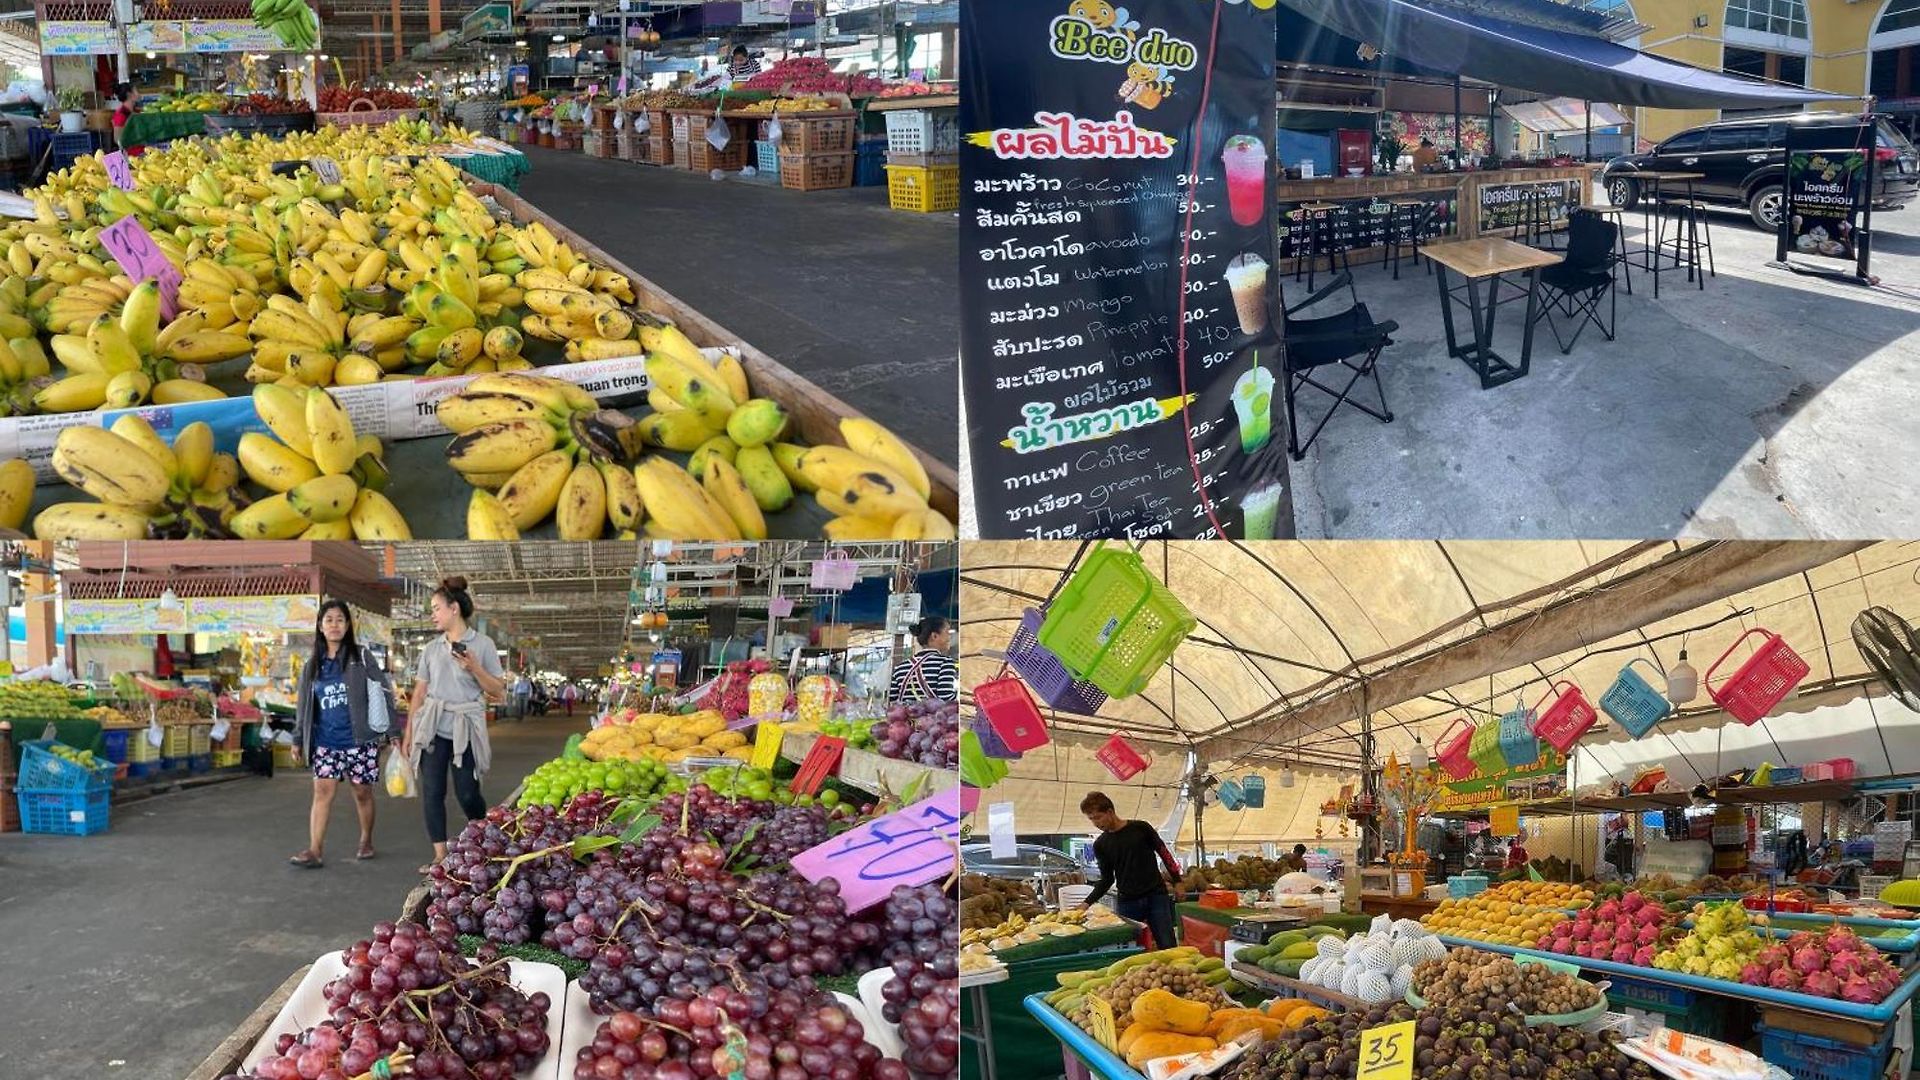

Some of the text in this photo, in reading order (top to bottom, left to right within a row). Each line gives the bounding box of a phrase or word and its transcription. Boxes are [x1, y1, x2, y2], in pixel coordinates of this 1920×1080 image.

[1055, 18, 1195, 68] Bee duo
[995, 112, 1170, 156] ผลไม้ปั่น
[973, 172, 1062, 193] มะพร้าว
[976, 200, 1082, 228] ส้มคั้นสด
[979, 234, 1085, 262] อาโวคาโด
[987, 264, 1060, 291] แตงโม
[990, 303, 1060, 324] มะม่วง
[992, 333, 1084, 358] สับปะรด
[612, 373, 648, 391] trọng
[996, 360, 1104, 390] มะเขือเทศ
[1064, 351, 1235, 410] ผลไม้รวม 50.-
[1013, 400, 1161, 451] น้ำหวาน
[1003, 461, 1069, 491] กาแฟ
[1006, 491, 1083, 522] ชาเขียว
[1365, 1031, 1403, 1066] 35
